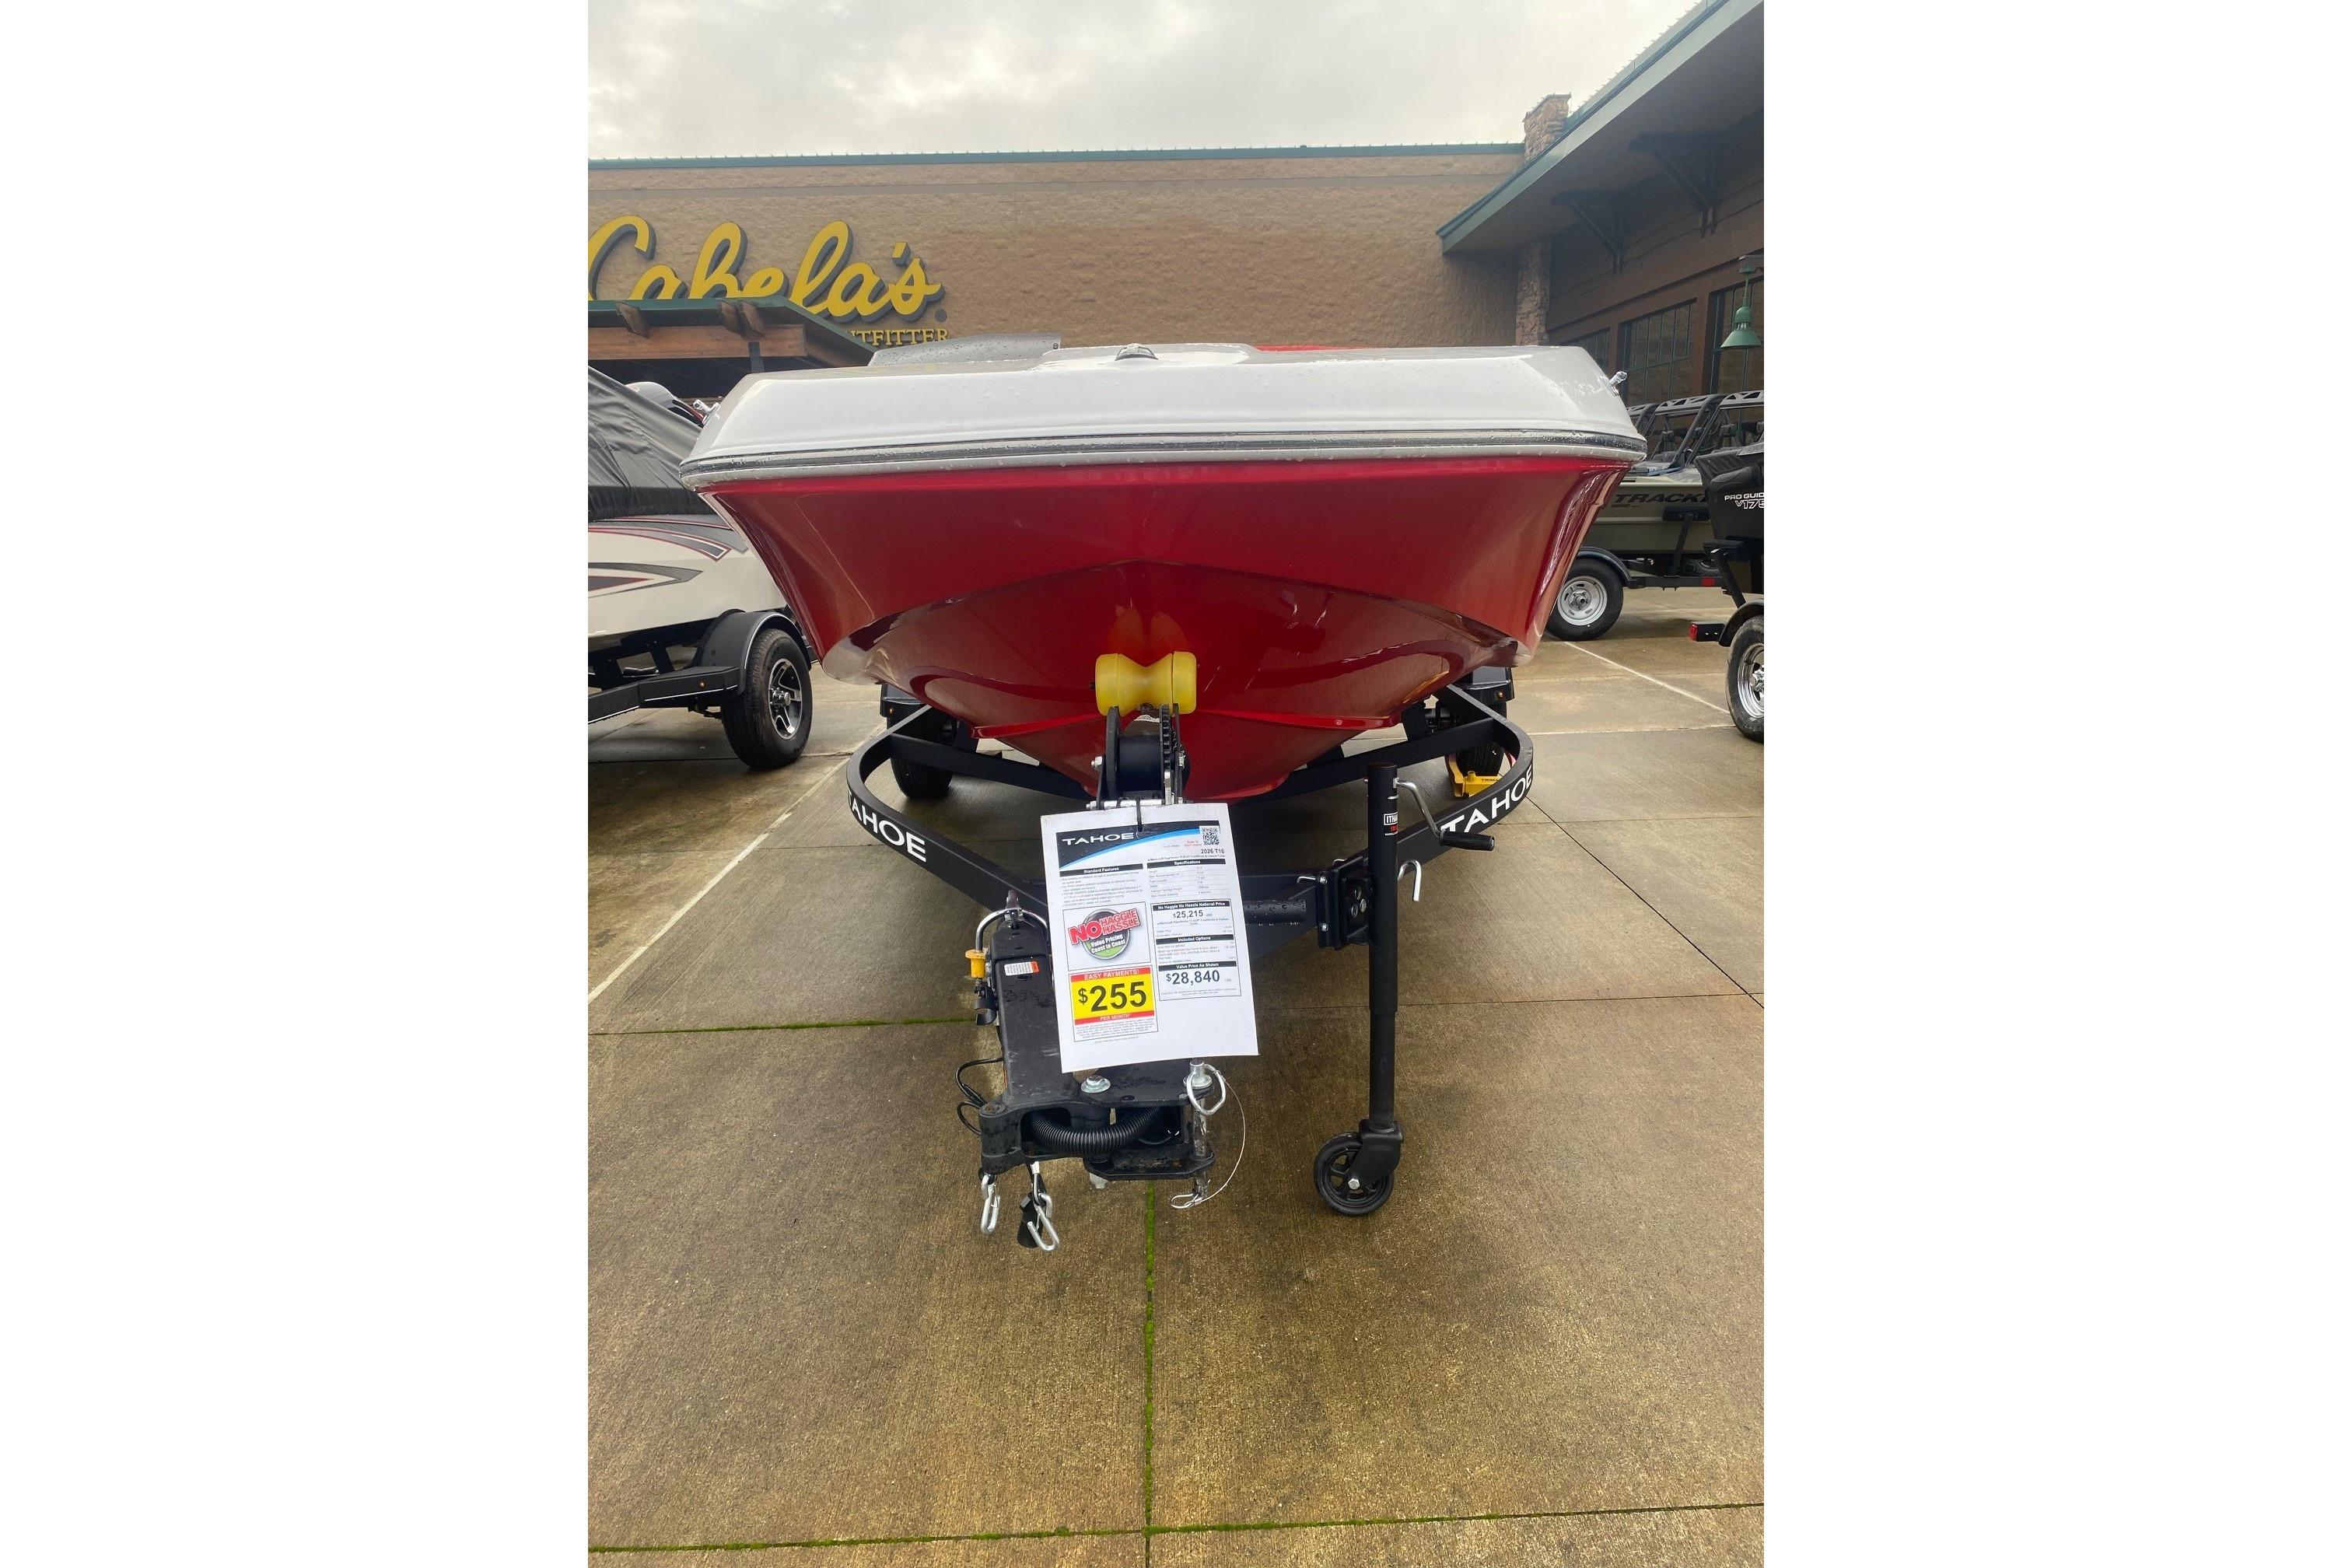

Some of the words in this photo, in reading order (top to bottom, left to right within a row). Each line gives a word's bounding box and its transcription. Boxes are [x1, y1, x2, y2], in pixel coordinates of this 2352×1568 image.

[848, 328, 948, 345] TFITTER
[847, 788, 926, 863] TAHOE
[1062, 832, 1135, 845] TAHOE
[1100, 908, 1138, 926] HAGGLE
[1173, 910, 1203, 919] $25,215
[1069, 921, 1102, 945] NO
[1102, 917, 1141, 935] HASSLE
[1090, 939, 1105, 947] Value
[1104, 934, 1124, 944] Pricing
[1090, 945, 1106, 954] Coast
[1111, 940, 1127, 949] Coast
[1103, 969, 1139, 978] PAYMENTS!
[1166, 970, 1220, 985] $28,840
[1077, 981, 1147, 1013] $255
